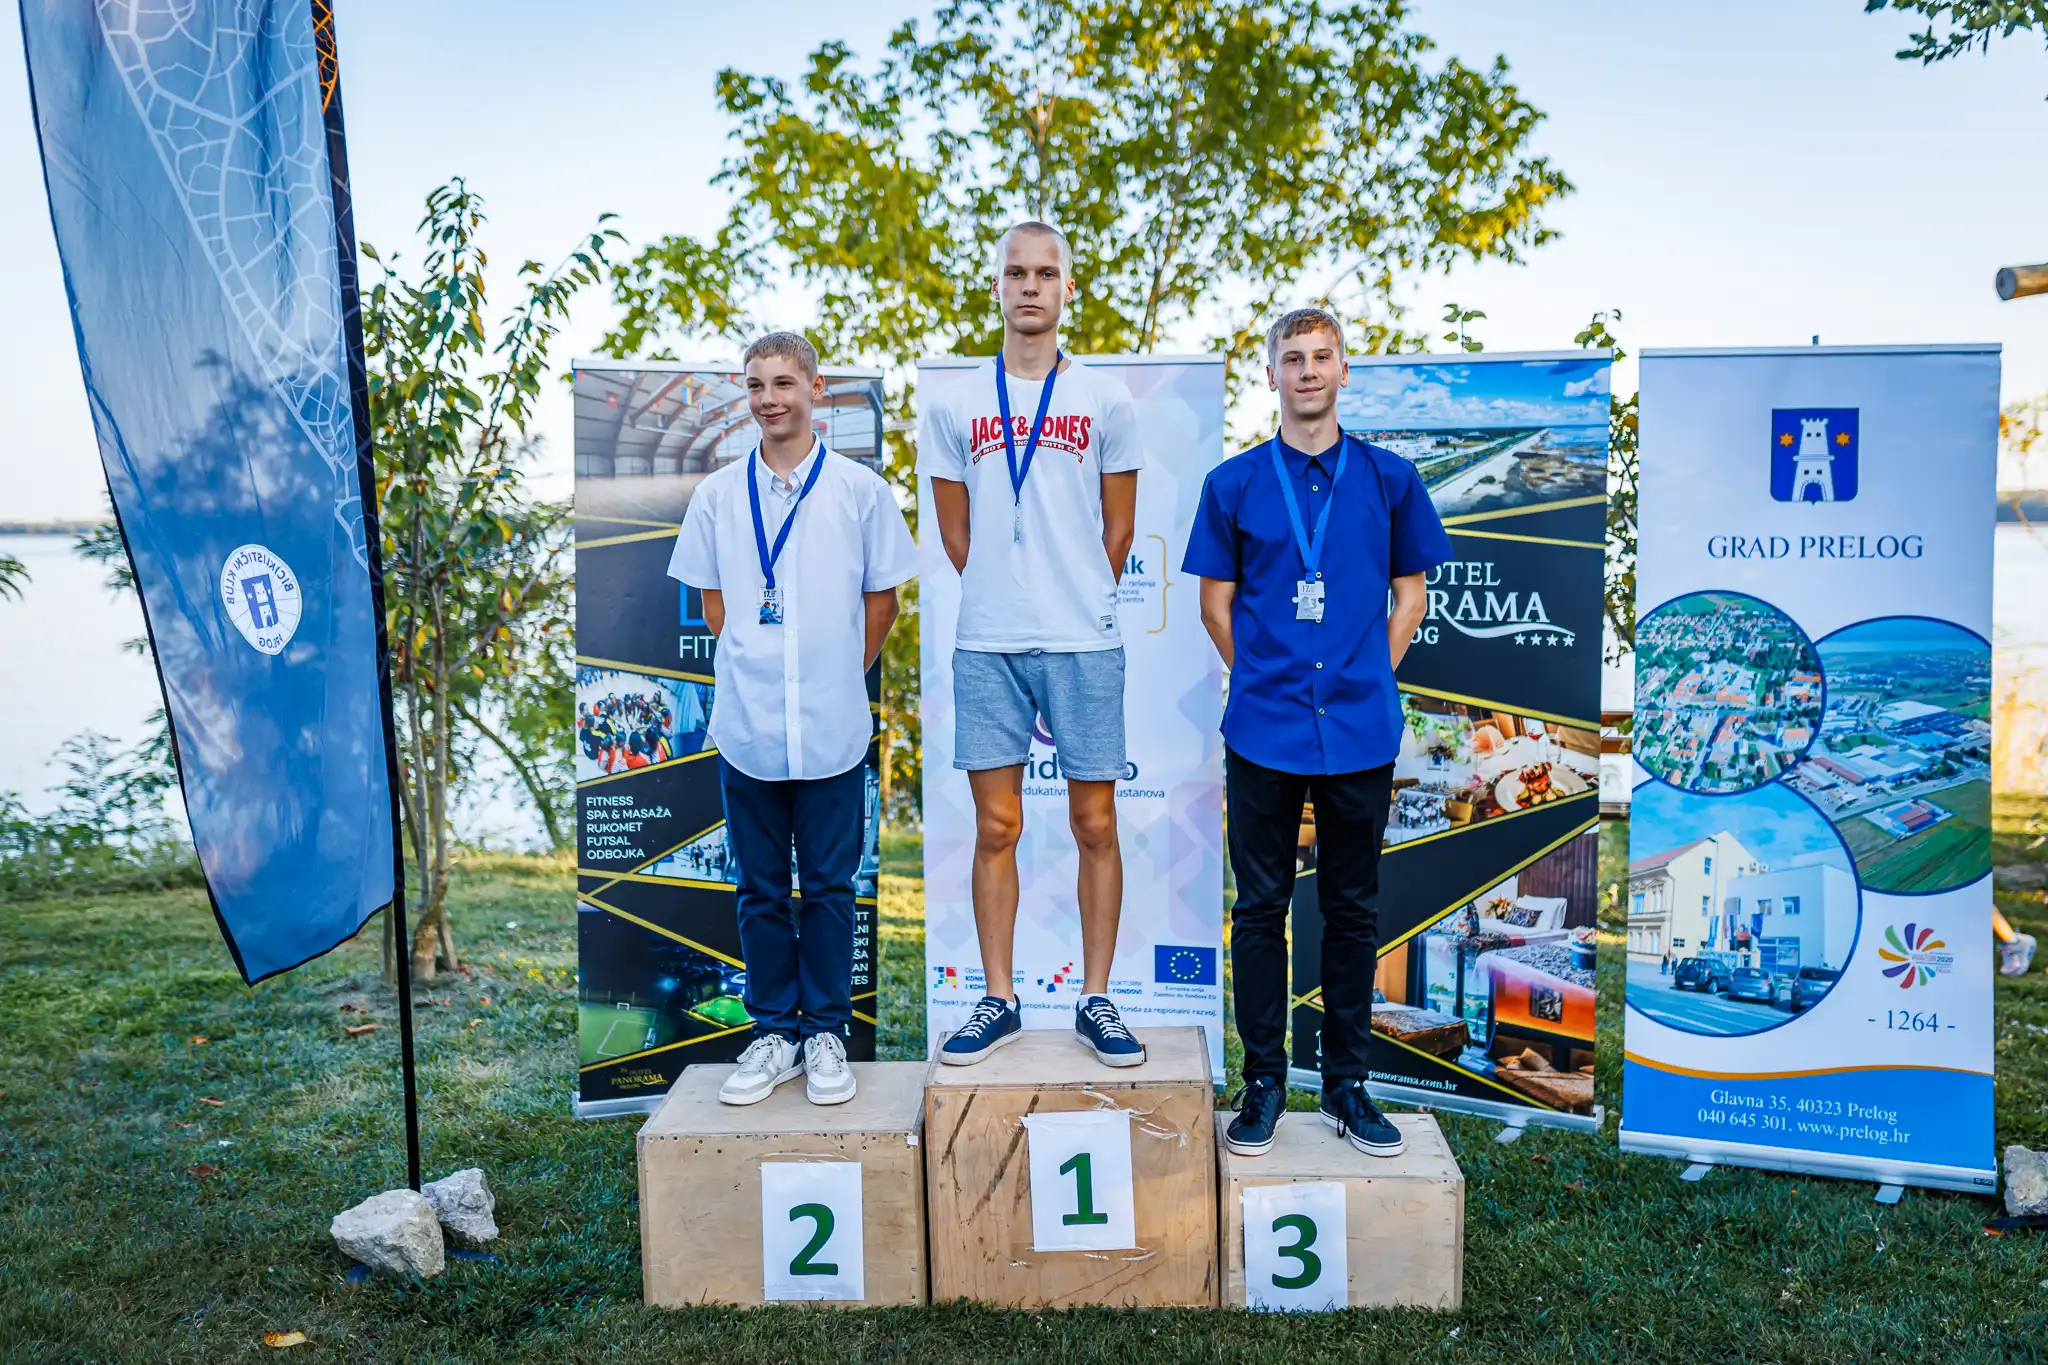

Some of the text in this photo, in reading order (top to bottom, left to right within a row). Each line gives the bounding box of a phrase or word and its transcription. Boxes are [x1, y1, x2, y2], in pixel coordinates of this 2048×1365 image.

[983, 443, 1002, 453] NOT
[1041, 441, 1064, 450] WITH
[1708, 535, 1924, 560] GRAD PRELOG
[1425, 561, 1501, 586] OTEL
[1425, 589, 1550, 624] RAMA
[586, 795, 634, 807] FITNESS
[1116, 788, 1165, 798] ustanova
[586, 805, 672, 820] SPA & MASAŽA
[586, 822, 643, 833] RUKOMET
[586, 836, 632, 847] FUTSAL
[586, 848, 646, 860] ODBOJKA
[1022, 1003, 1051, 1011] uropska
[1887, 1010, 1939, 1032] 1264
[1710, 1089, 1764, 1109] Glavna
[1796, 1098, 1842, 1116] 40323
[1848, 1102, 1897, 1124] Prelog
[1697, 1108, 1725, 1124] 040
[1729, 1112, 1756, 1127] 645
[1797, 1120, 1911, 1144] www.prelog.hr
[1060, 1153, 1108, 1225] 1
[789, 1203, 838, 1275] 2
[1272, 1214, 1321, 1289] 3
